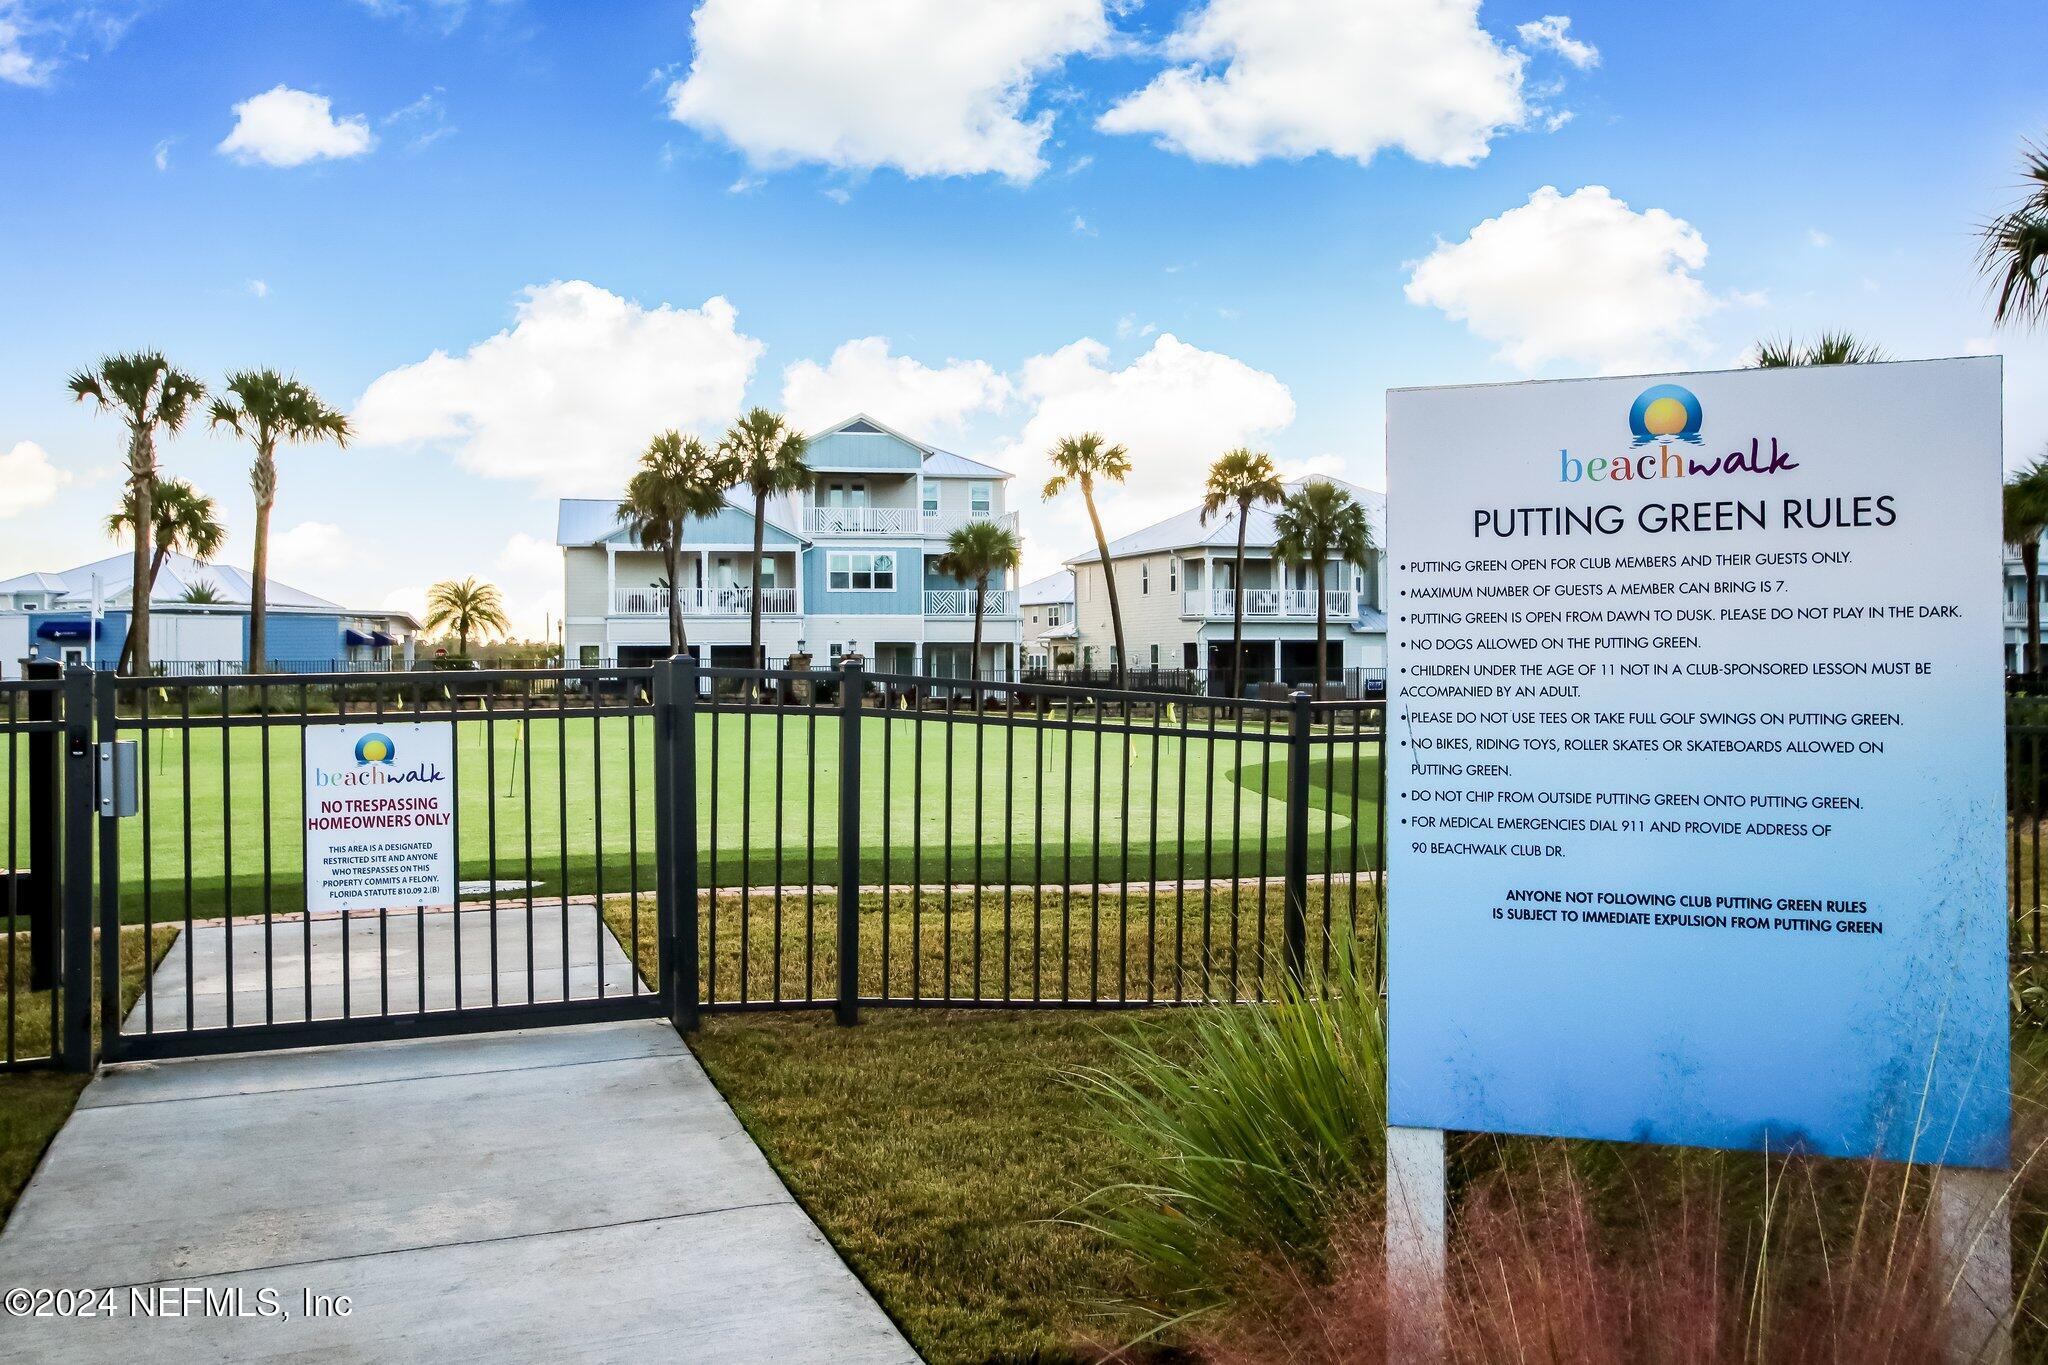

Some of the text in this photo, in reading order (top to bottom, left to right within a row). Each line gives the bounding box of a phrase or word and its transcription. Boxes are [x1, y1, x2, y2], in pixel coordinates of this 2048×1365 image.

[1559, 437, 1800, 483] beachwalk
[1475, 495, 1896, 537] PUTTING GREEN RULES
[1411, 551, 1852, 573] PUTTING GREEN OPEN FOR CLUB MEMBERS AND THEIR GUESTS ONLY.
[1410, 580, 1788, 599] MAXIMUM NUMBER OF GUESTS A MEMBER CAN BRING IS 7.
[1411, 605, 1962, 625] PUTTING GREEN IS OPEN FROM DAWN TO DUSK. PLEASE DO NOT PLAY IN THE DARK.
[1411, 636, 1701, 650] NO DOGS ALLOWED ON THE PUTTING GREEN.
[1411, 662, 1931, 676] CHILDREN UNDER THE AGE OF 11 NOT IN A CLUB-SPONSORED LESSON MUST BE
[1399, 686, 1580, 697] ACCOMPANIED BY AN ADULT.
[1411, 712, 1903, 726] PLEASE DO NOT USE TEES OR TAKE FULL GOLF SWINGS ON PUTTING GREEN.
[1411, 738, 1883, 754] NO BIKES, RIDING TOYS, ROLLER SKATES OR SKATEBOARDS ALLOWED ON
[316, 763, 446, 787] beachwalk
[1412, 763, 1512, 776] PUTTING GREEN.
[321, 797, 438, 813] NO TRESPASSING
[1412, 790, 1863, 809] DO NOT CHIP FROM OUTSIDE PUTTING GREEN ONTO PUTTING GREEN.
[309, 813, 450, 830] HOMEOWNERS ONLY
[1412, 816, 1831, 837] FOR MEDICAL EMERGENCIES DIAL 911 AND PROVIDE ADDRESS OF
[348, 845, 368, 853] AREA
[369, 844, 377, 852] IS
[385, 842, 432, 851] DESIGNATED
[1412, 842, 1565, 857] 90 BEACHWALK CLUB DR.
[323, 853, 438, 865] RESTRICTED SITE AND ANYONE
[331, 864, 430, 876] WHO TRESPASSES ON THIS
[323, 879, 363, 887] PROPERTY
[364, 876, 401, 885] COMMITS
[408, 875, 439, 883] FELONY.
[329, 890, 363, 899] FLORIDA
[364, 888, 397, 897] STATUTE
[398, 887, 422, 895] 810.09
[1506, 890, 1867, 914] ANYONE NOT FOLLOWING CLUB PUTTING GREEN RULES
[1493, 908, 1882, 934] IS SUBJECT TO IMMEDIATE EXPULSION FROM PUTTING GREEN
